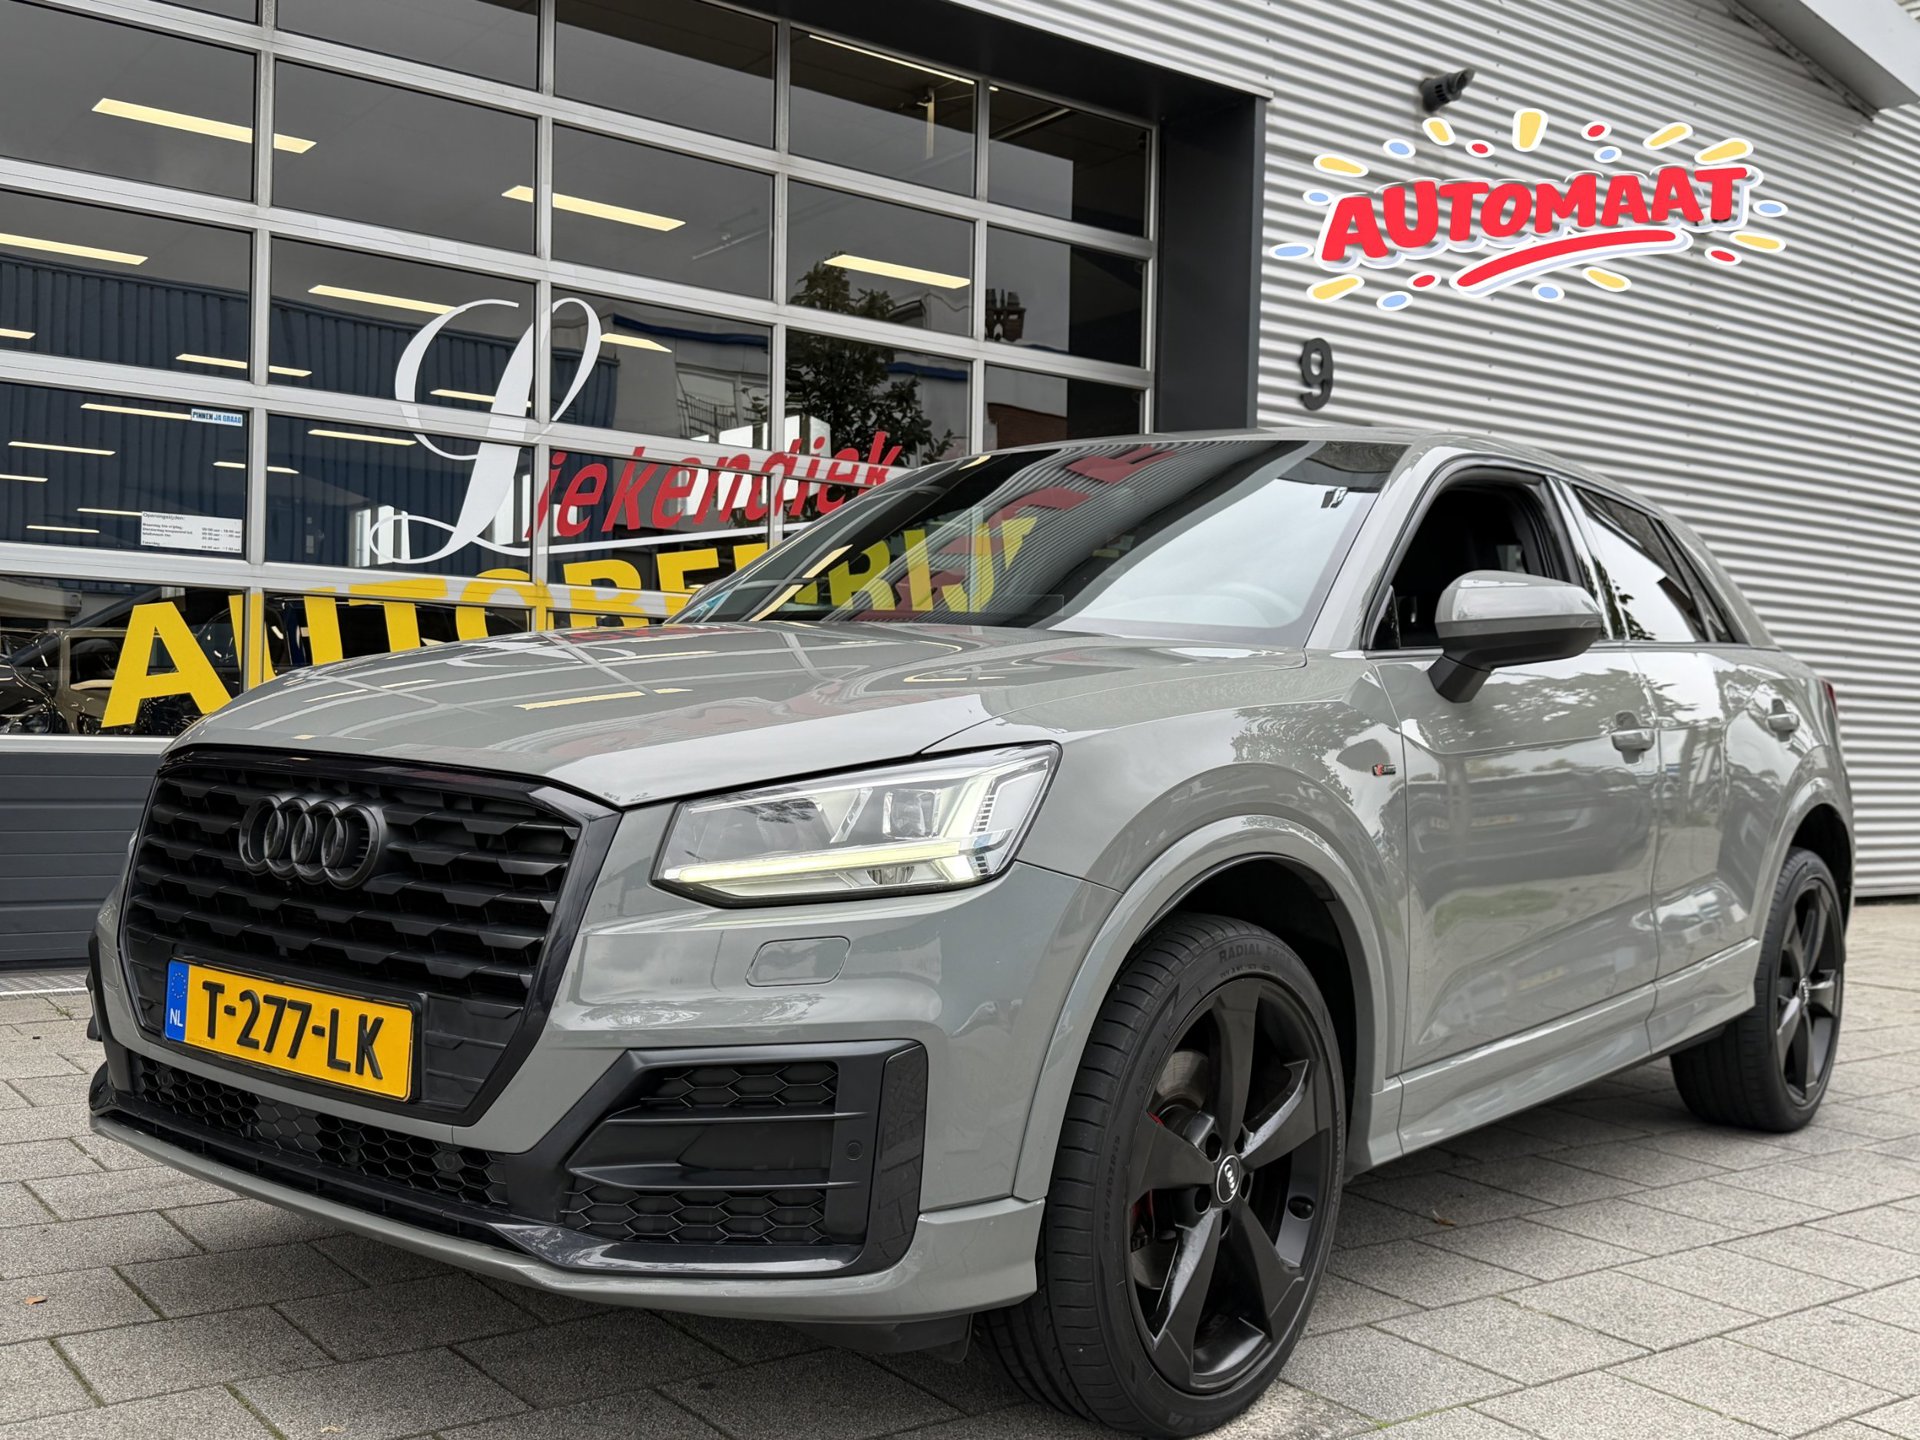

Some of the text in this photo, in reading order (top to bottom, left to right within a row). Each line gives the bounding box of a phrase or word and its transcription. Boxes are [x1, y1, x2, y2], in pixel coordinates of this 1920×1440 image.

[1299, 337, 1334, 412] 9
[1219, 943, 1262, 963] RADIAL
[168, 1008, 184, 1029] NL
[202, 980, 384, 1080] T-277-LK
